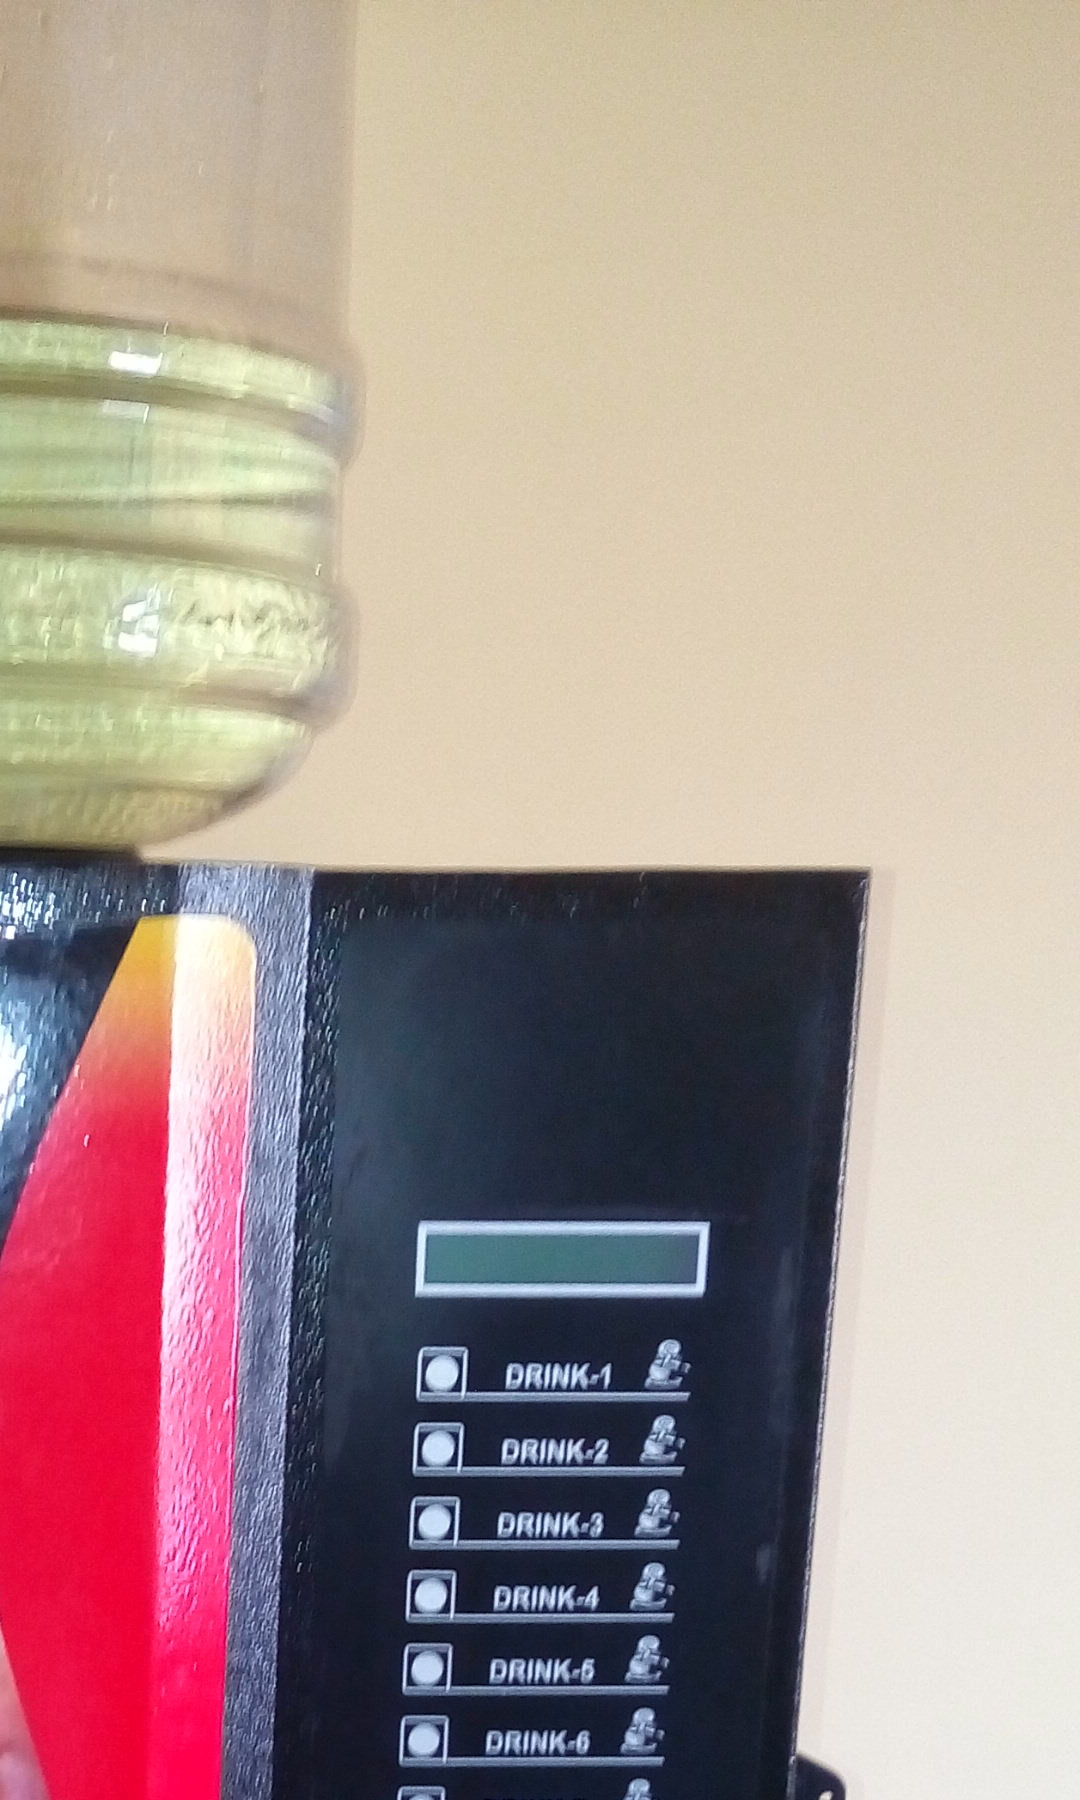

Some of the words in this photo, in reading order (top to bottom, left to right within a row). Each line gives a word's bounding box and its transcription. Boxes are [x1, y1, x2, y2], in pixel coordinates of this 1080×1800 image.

[505, 1362, 614, 1390] DRINK-1
[500, 1437, 610, 1465] DRINK-2
[497, 1512, 605, 1539] DRINK-3
[493, 1585, 600, 1611] DRINK-4
[488, 1658, 595, 1684] DRINK-5
[485, 1730, 591, 1755] DRINK-6
